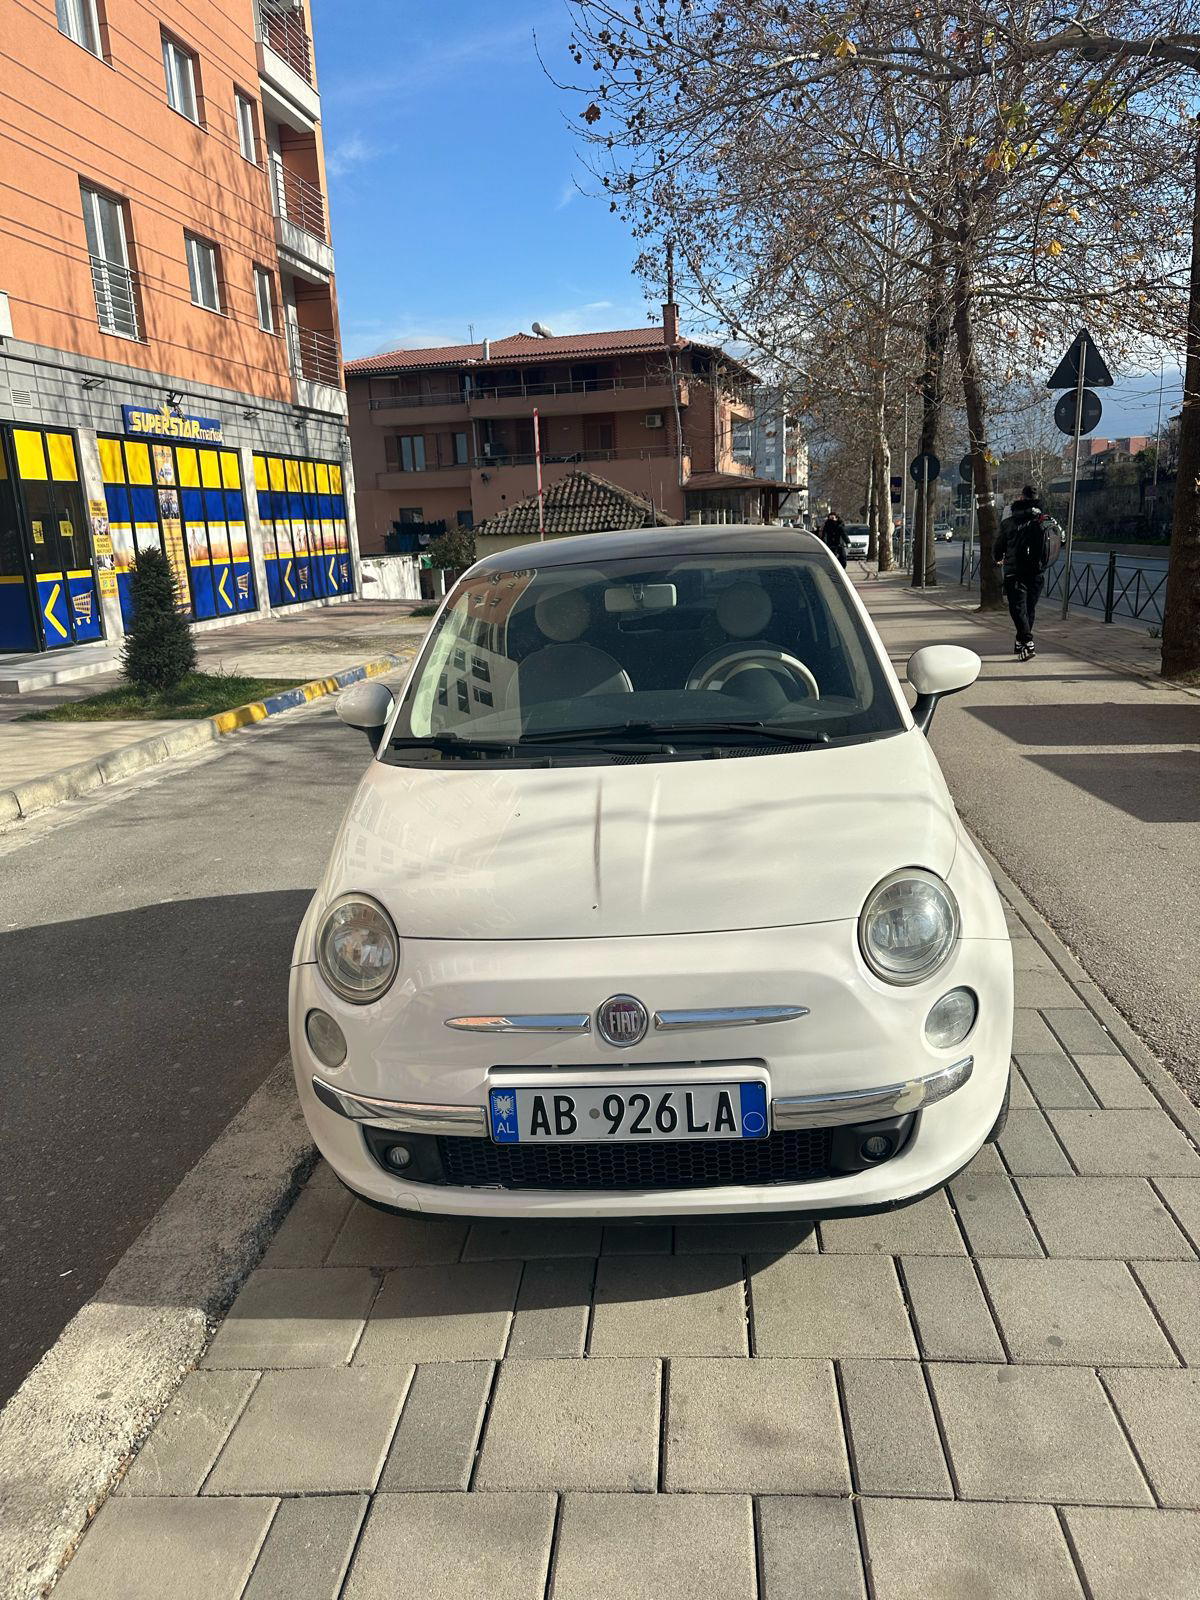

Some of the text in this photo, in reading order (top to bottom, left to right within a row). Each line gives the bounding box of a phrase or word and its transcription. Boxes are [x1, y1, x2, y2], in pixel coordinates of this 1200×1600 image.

[129, 411, 199, 438] SUPERSTAR
[609, 1010, 637, 1033] FIAT
[496, 1122, 516, 1134] AL
[530, 1095, 578, 1136] AB
